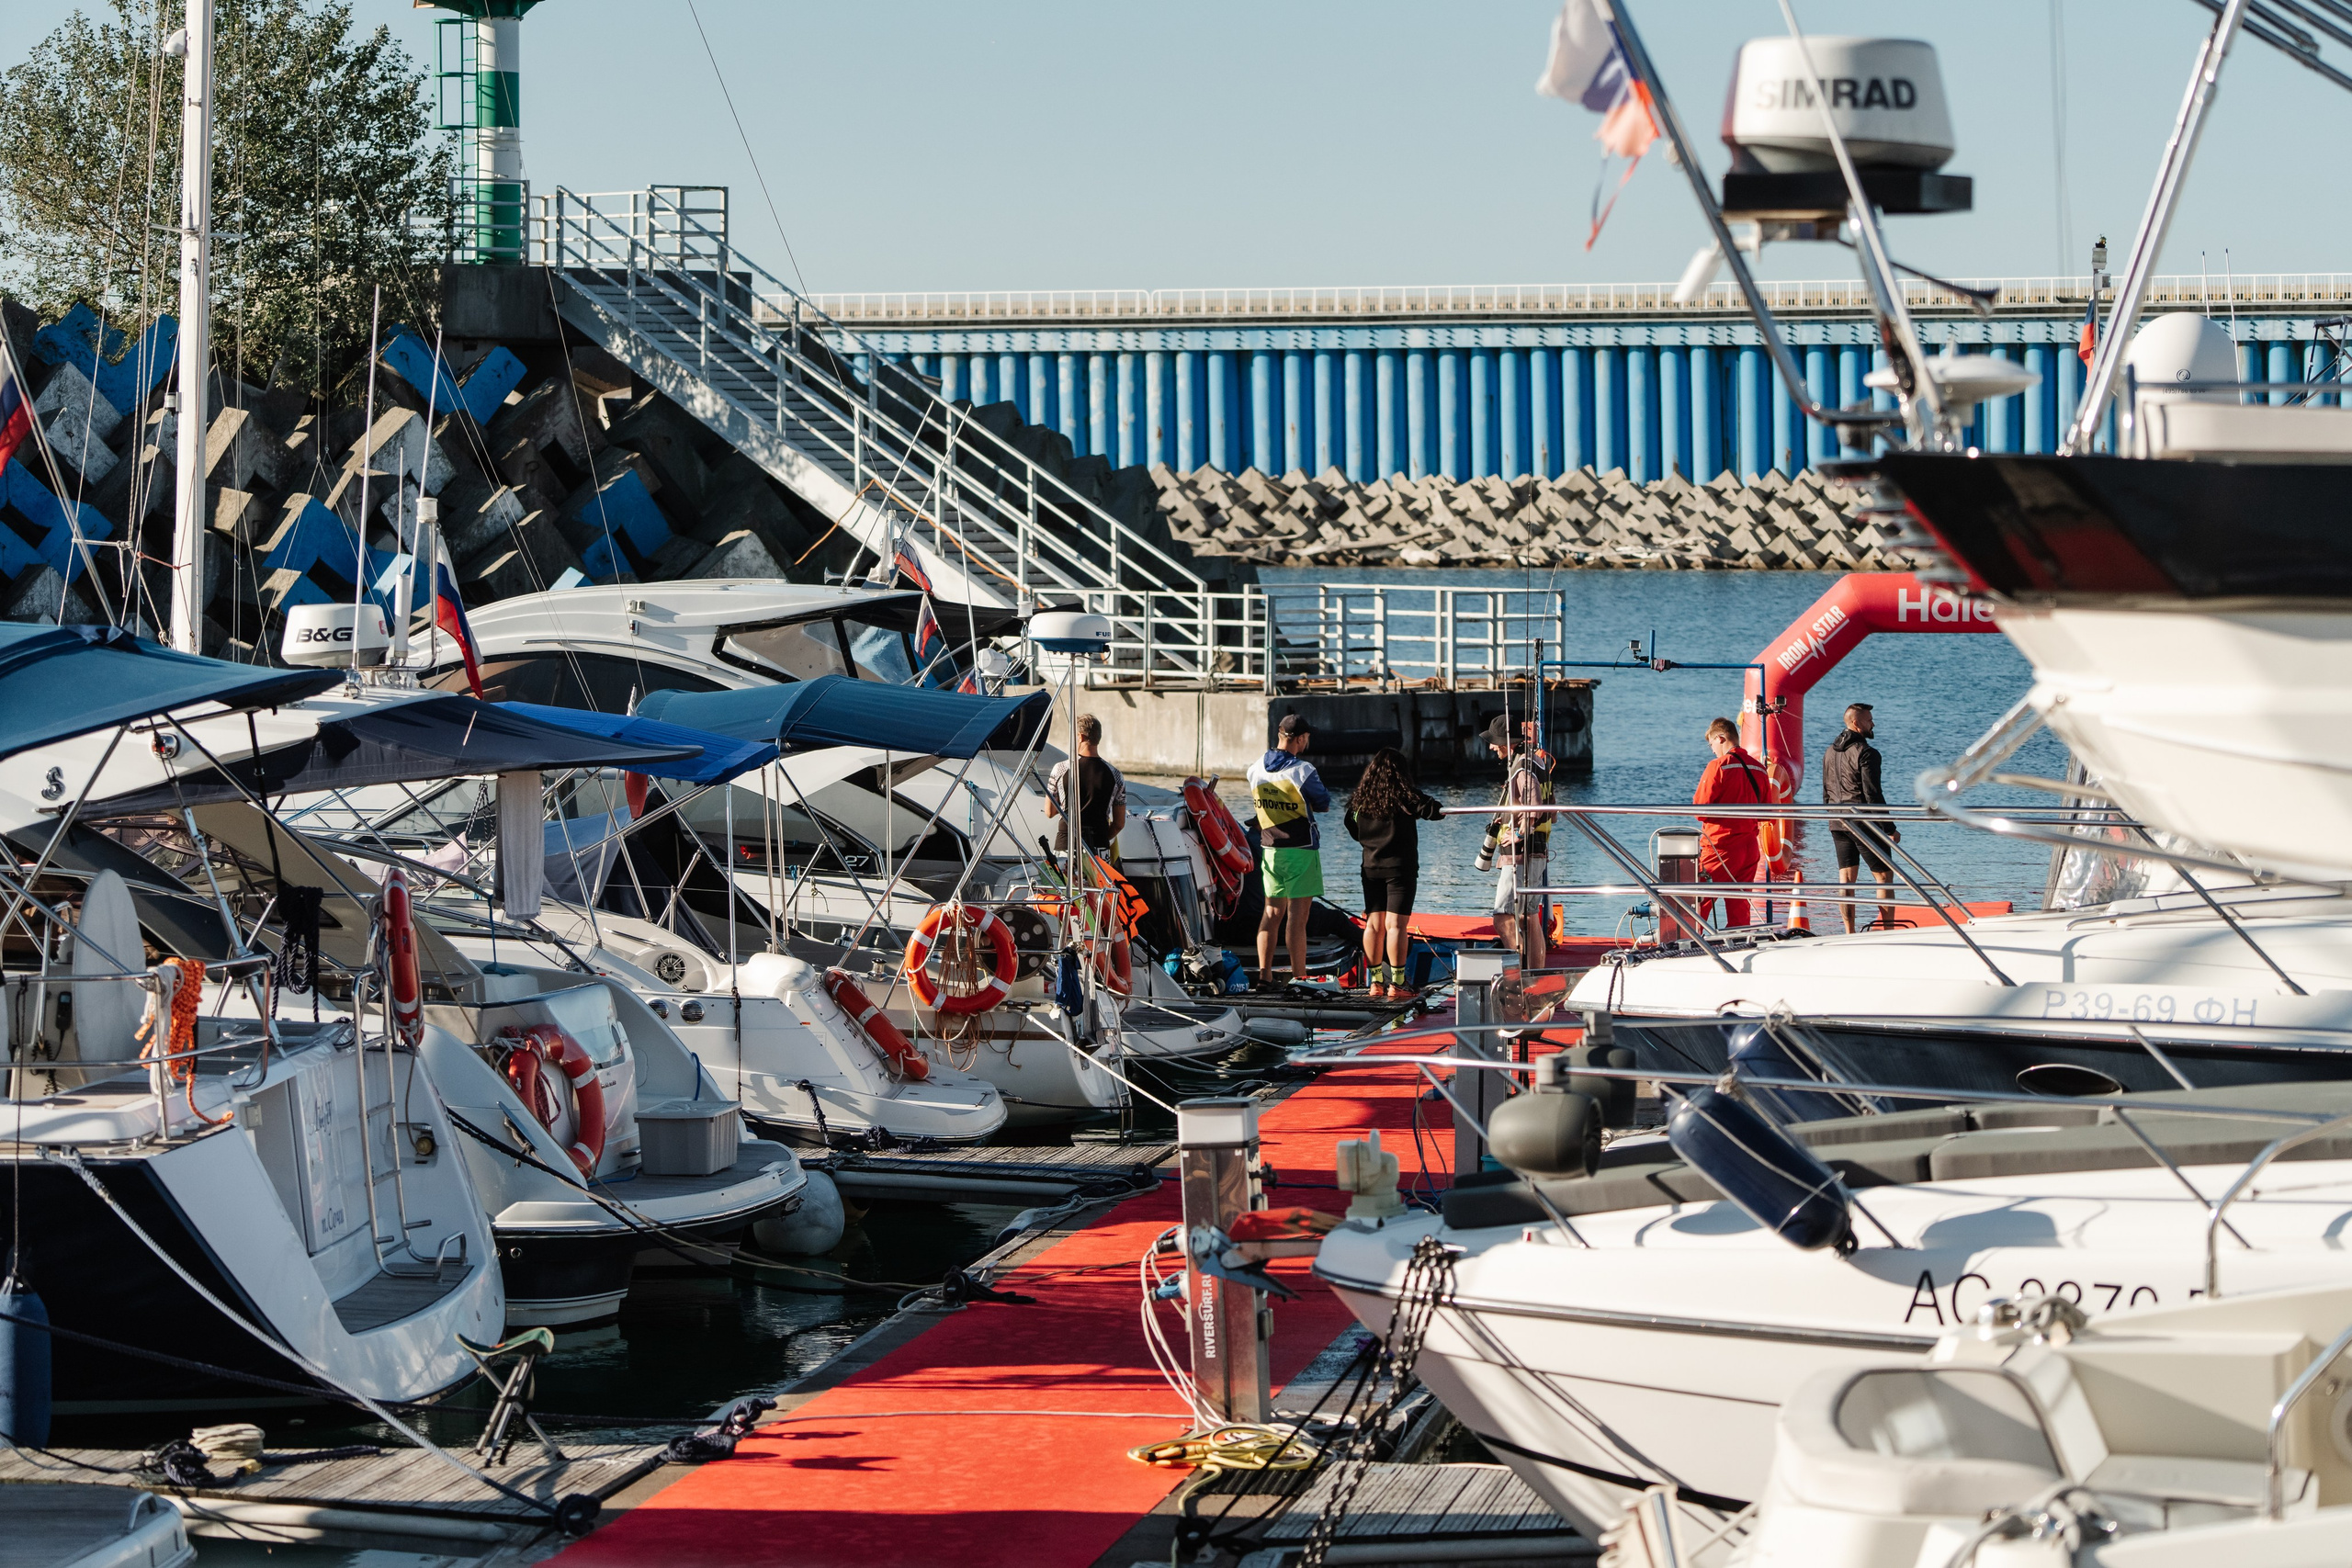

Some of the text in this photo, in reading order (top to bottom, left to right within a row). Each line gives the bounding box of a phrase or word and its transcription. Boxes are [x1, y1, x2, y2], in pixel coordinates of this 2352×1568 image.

[1756, 78, 1917, 110] SIMRAD
[296, 626, 354, 643] B&G
[1777, 605, 1847, 671] IRON STAR
[845, 854, 869, 867] 27
